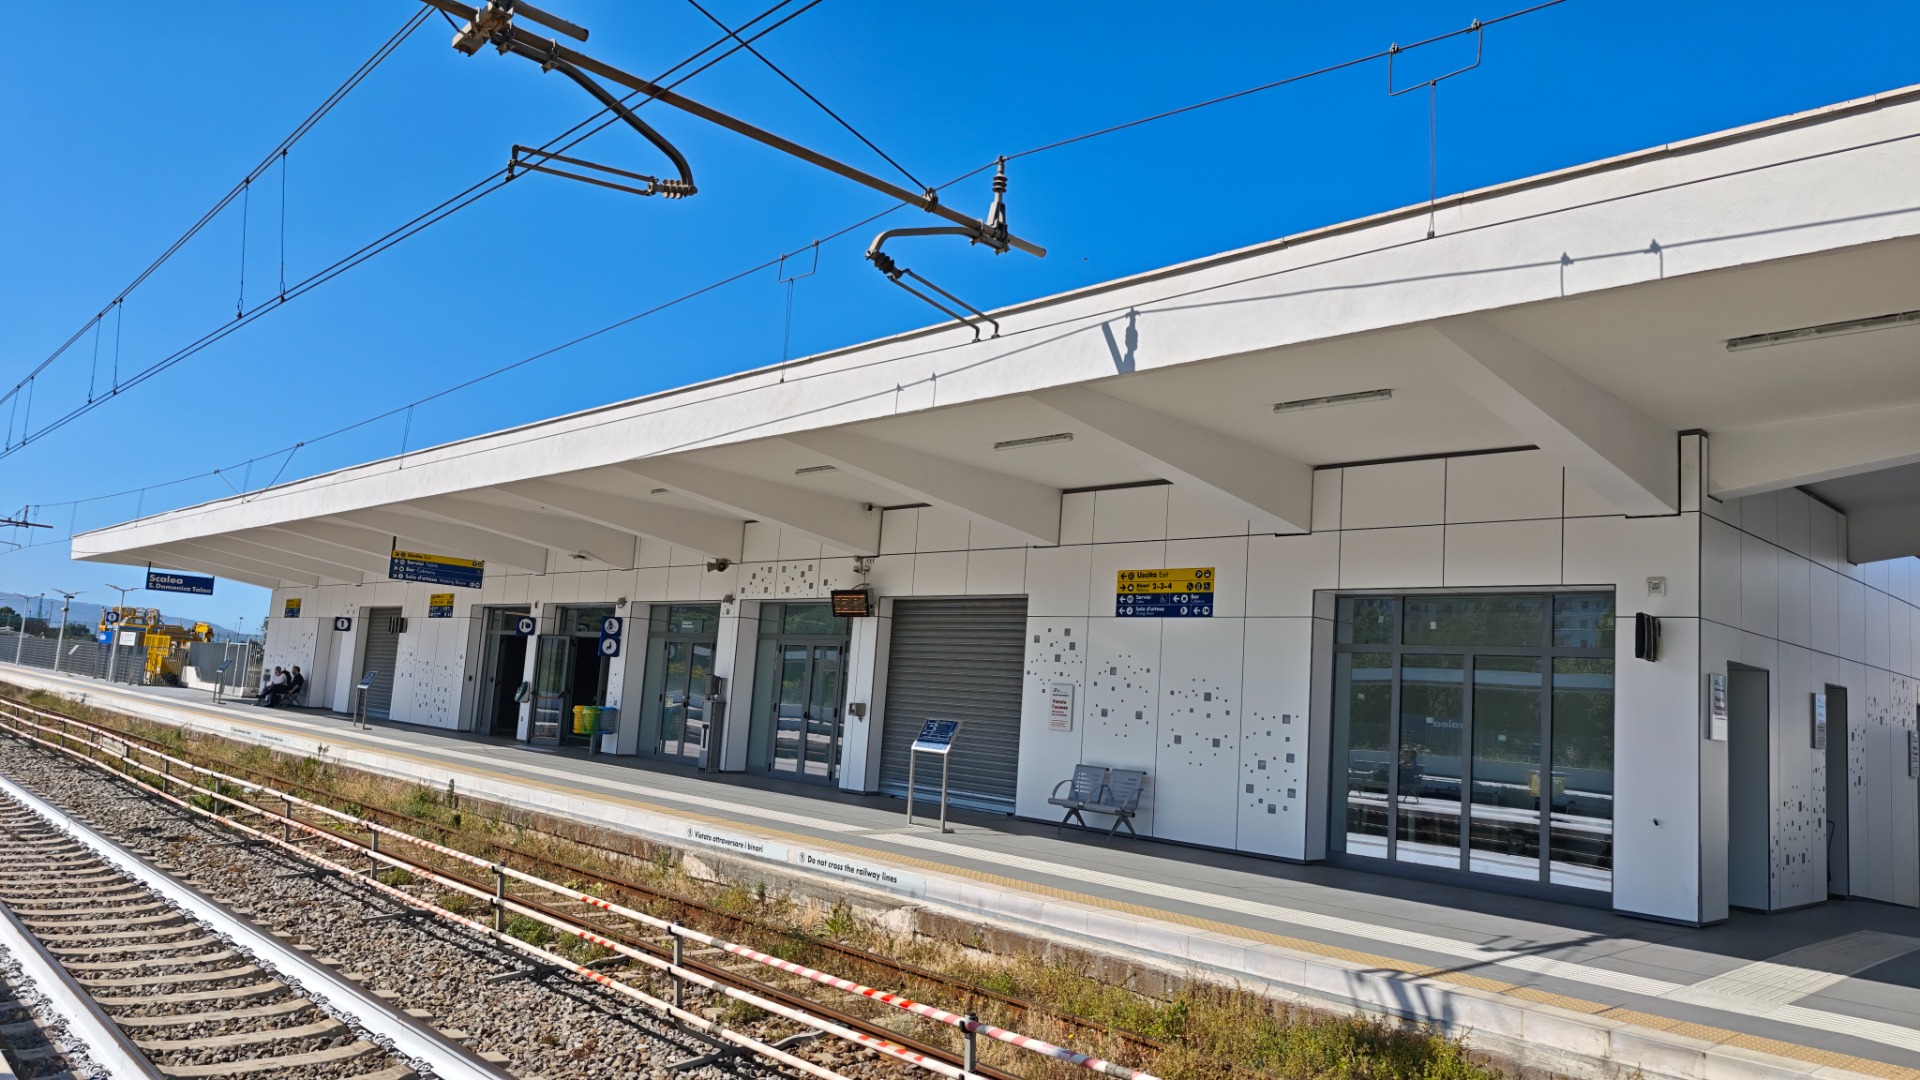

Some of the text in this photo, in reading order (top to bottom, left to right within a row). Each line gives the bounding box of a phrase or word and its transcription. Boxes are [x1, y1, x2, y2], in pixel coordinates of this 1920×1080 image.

[149, 574, 183, 584] Scalea
[1137, 570, 1157, 579] Uscita
[156, 583, 191, 592] Domenica
[695, 831, 712, 841] Vietato
[713, 836, 744, 848] attraversare
[748, 842, 763, 852] binari
[808, 856, 816, 864] Do
[828, 862, 843, 871] cross
[844, 864, 854, 874] the
[856, 868, 881, 881] railway
[882, 872, 897, 883] lines
